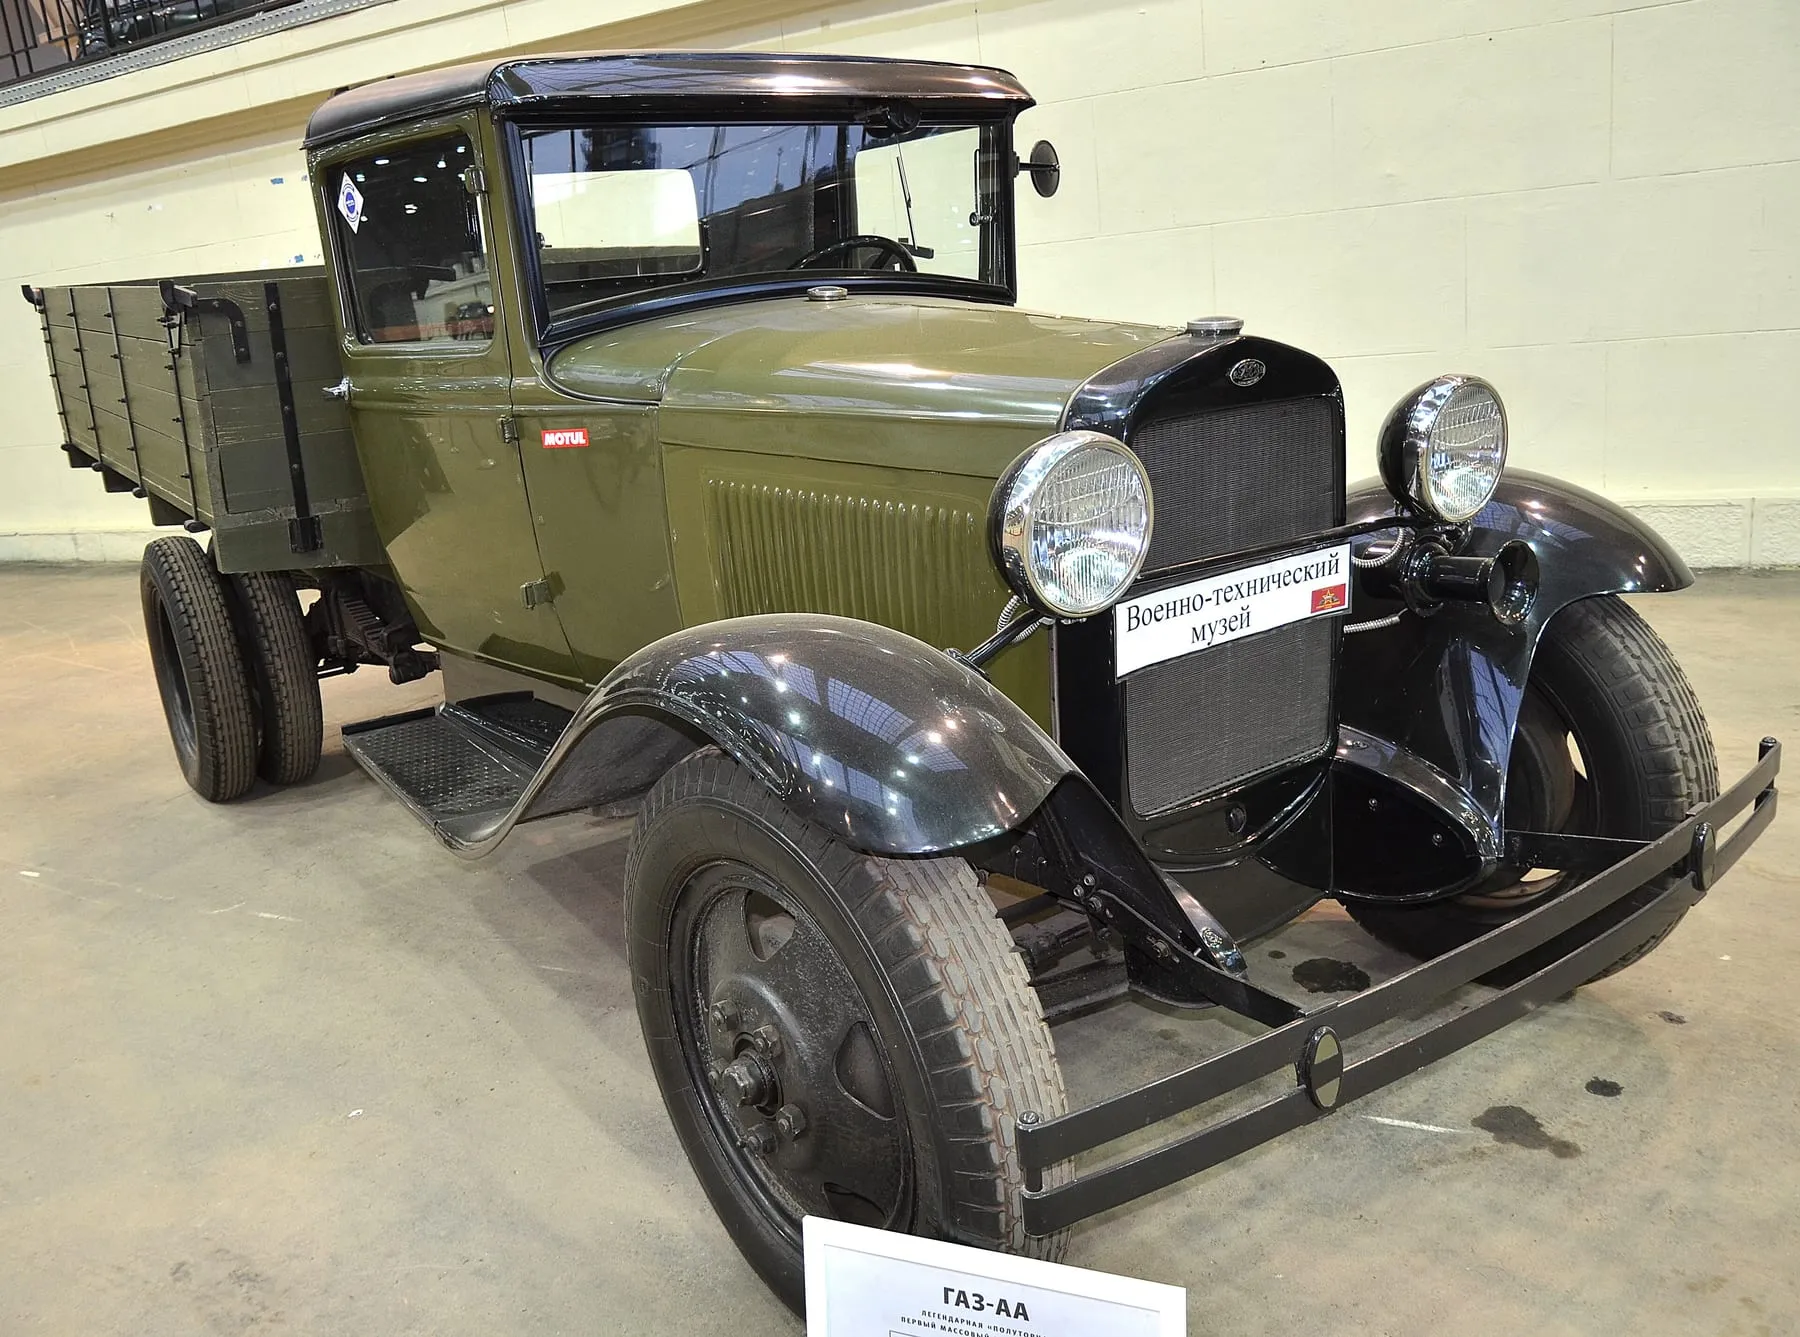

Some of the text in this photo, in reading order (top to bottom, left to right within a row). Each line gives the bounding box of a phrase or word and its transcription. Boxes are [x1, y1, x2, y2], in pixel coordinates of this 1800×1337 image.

[544, 431, 586, 446] MOTUL
[1126, 552, 1341, 632] Военно-технический
[1191, 605, 1251, 645] музей
[943, 1286, 1030, 1322] ГАЗ-АА
[901, 1316, 936, 1329] ПЕРВЫЙ
[922, 1310, 983, 1328] ЛЕГЕНДАРНАЯ
